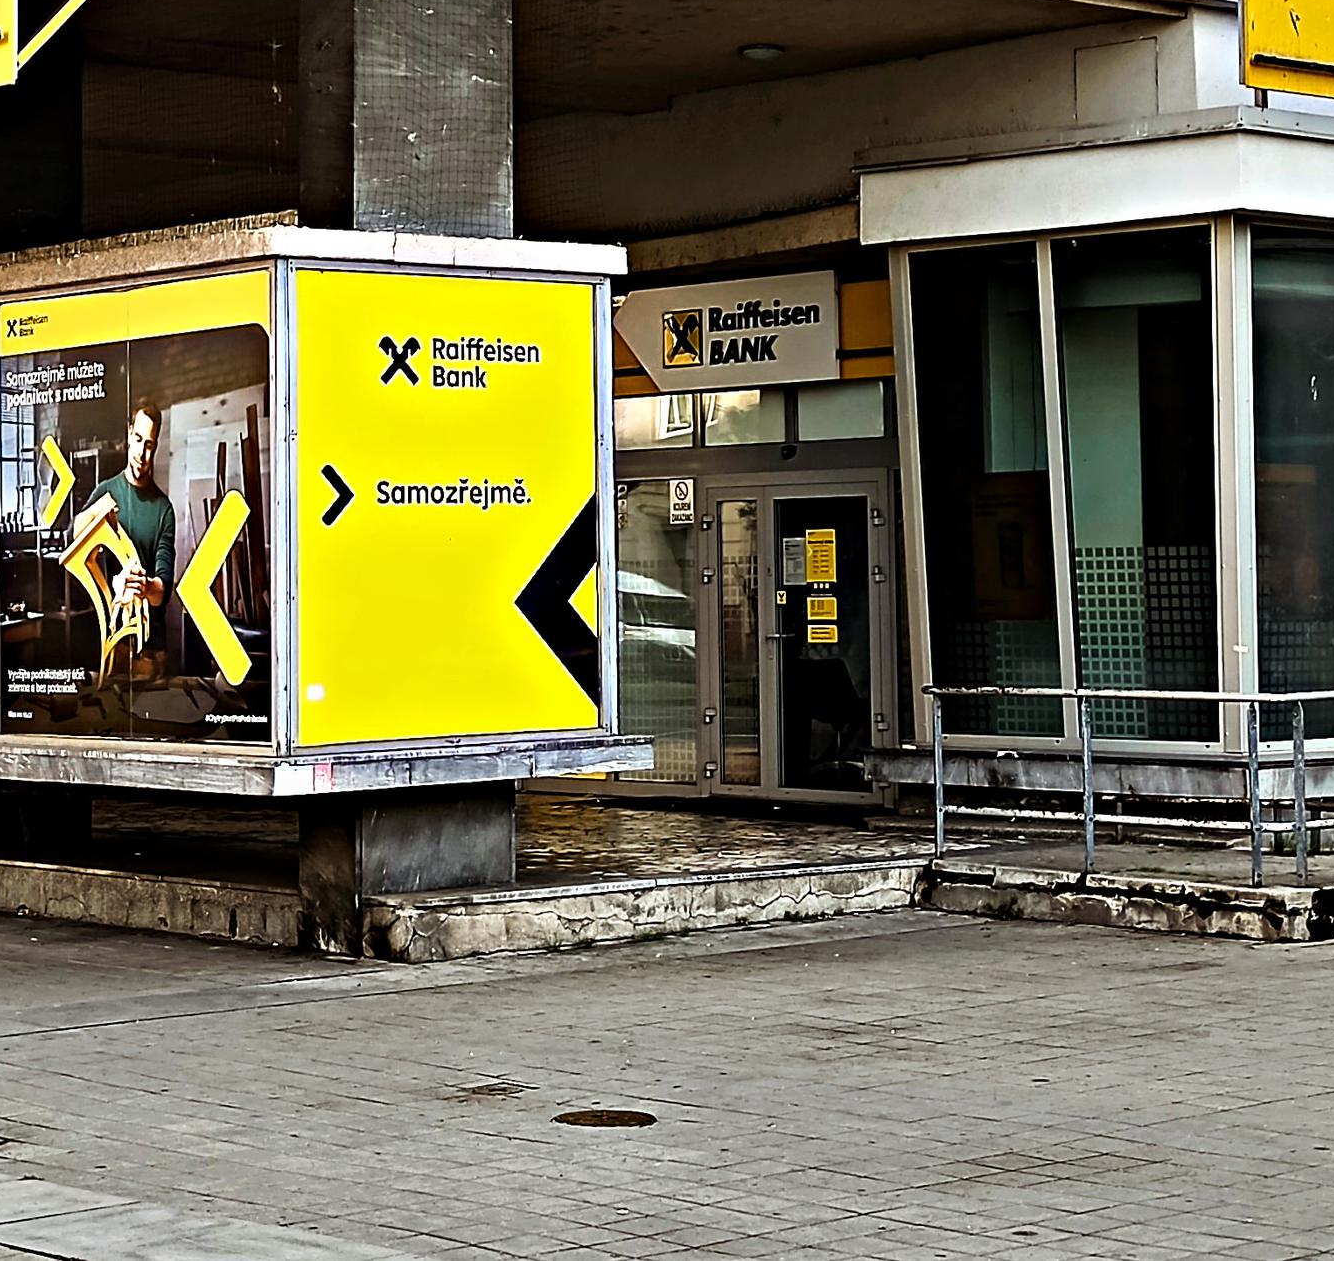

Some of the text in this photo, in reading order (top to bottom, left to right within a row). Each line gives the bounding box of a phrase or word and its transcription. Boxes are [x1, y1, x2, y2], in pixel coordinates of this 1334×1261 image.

[708, 299, 820, 365] Raiffeisen BANK
[433, 337, 539, 362] Raiffeisen
[7, 361, 105, 387] Samozřejmě můžete
[433, 365, 487, 388] Bank
[7, 379, 105, 411] podnikat s radostí.
[377, 479, 532, 510] Samozřejmě.
